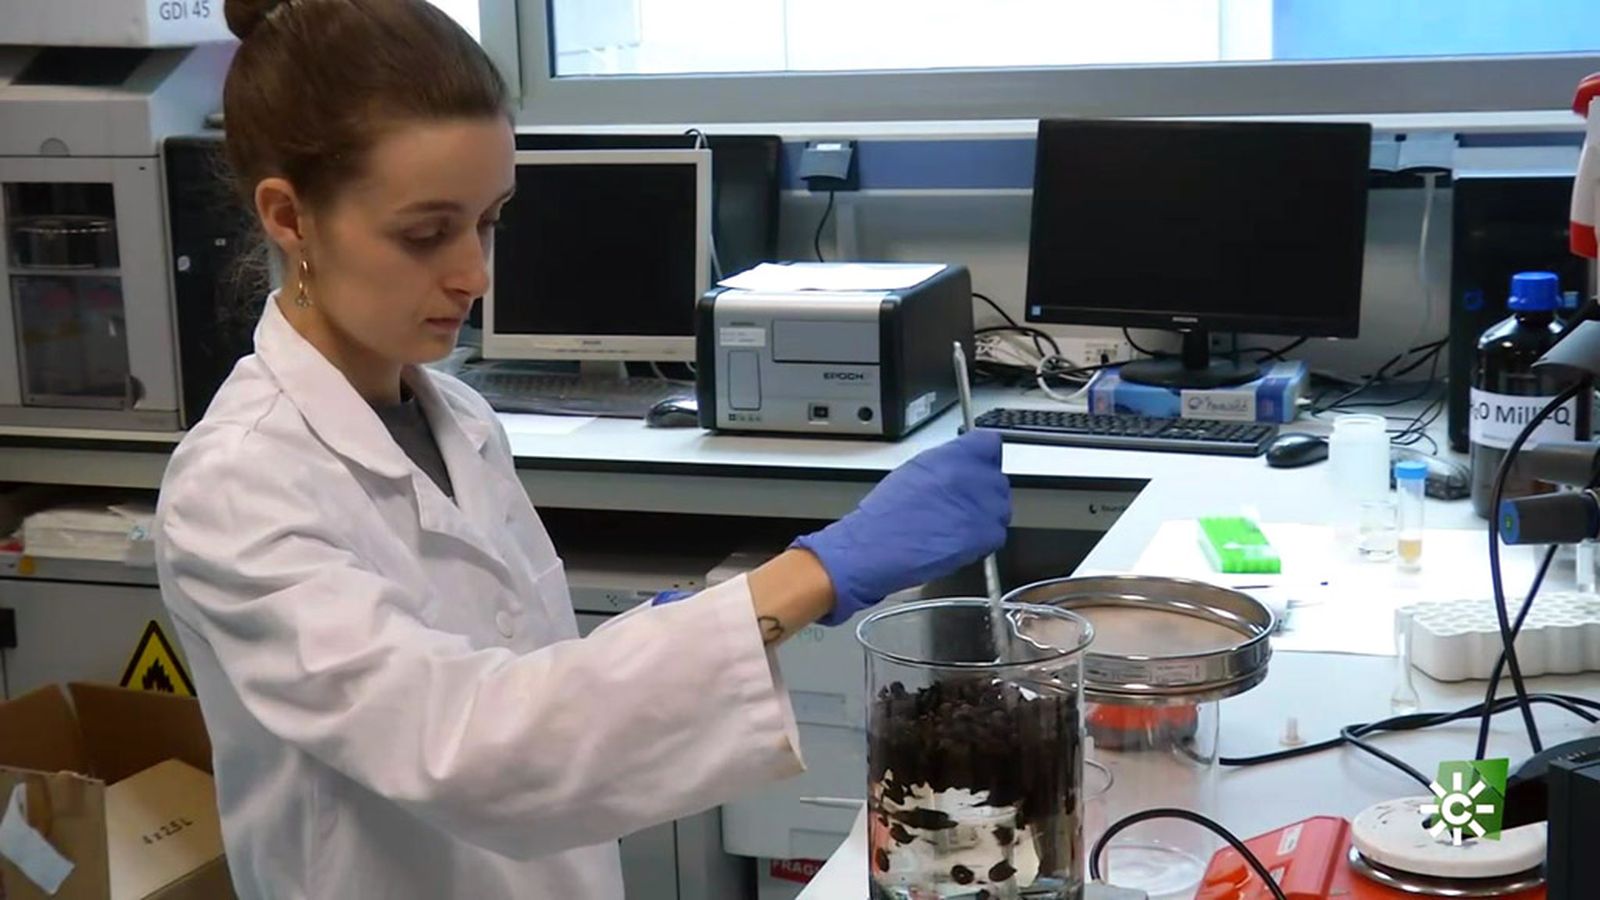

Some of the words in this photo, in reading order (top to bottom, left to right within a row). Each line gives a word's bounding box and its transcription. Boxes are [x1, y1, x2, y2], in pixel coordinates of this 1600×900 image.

[159, 1, 188, 20] GDI
[192, 0, 210, 19] 45
[1496, 404, 1571, 426] Mill-Q
[773, 860, 822, 876] FRAG
